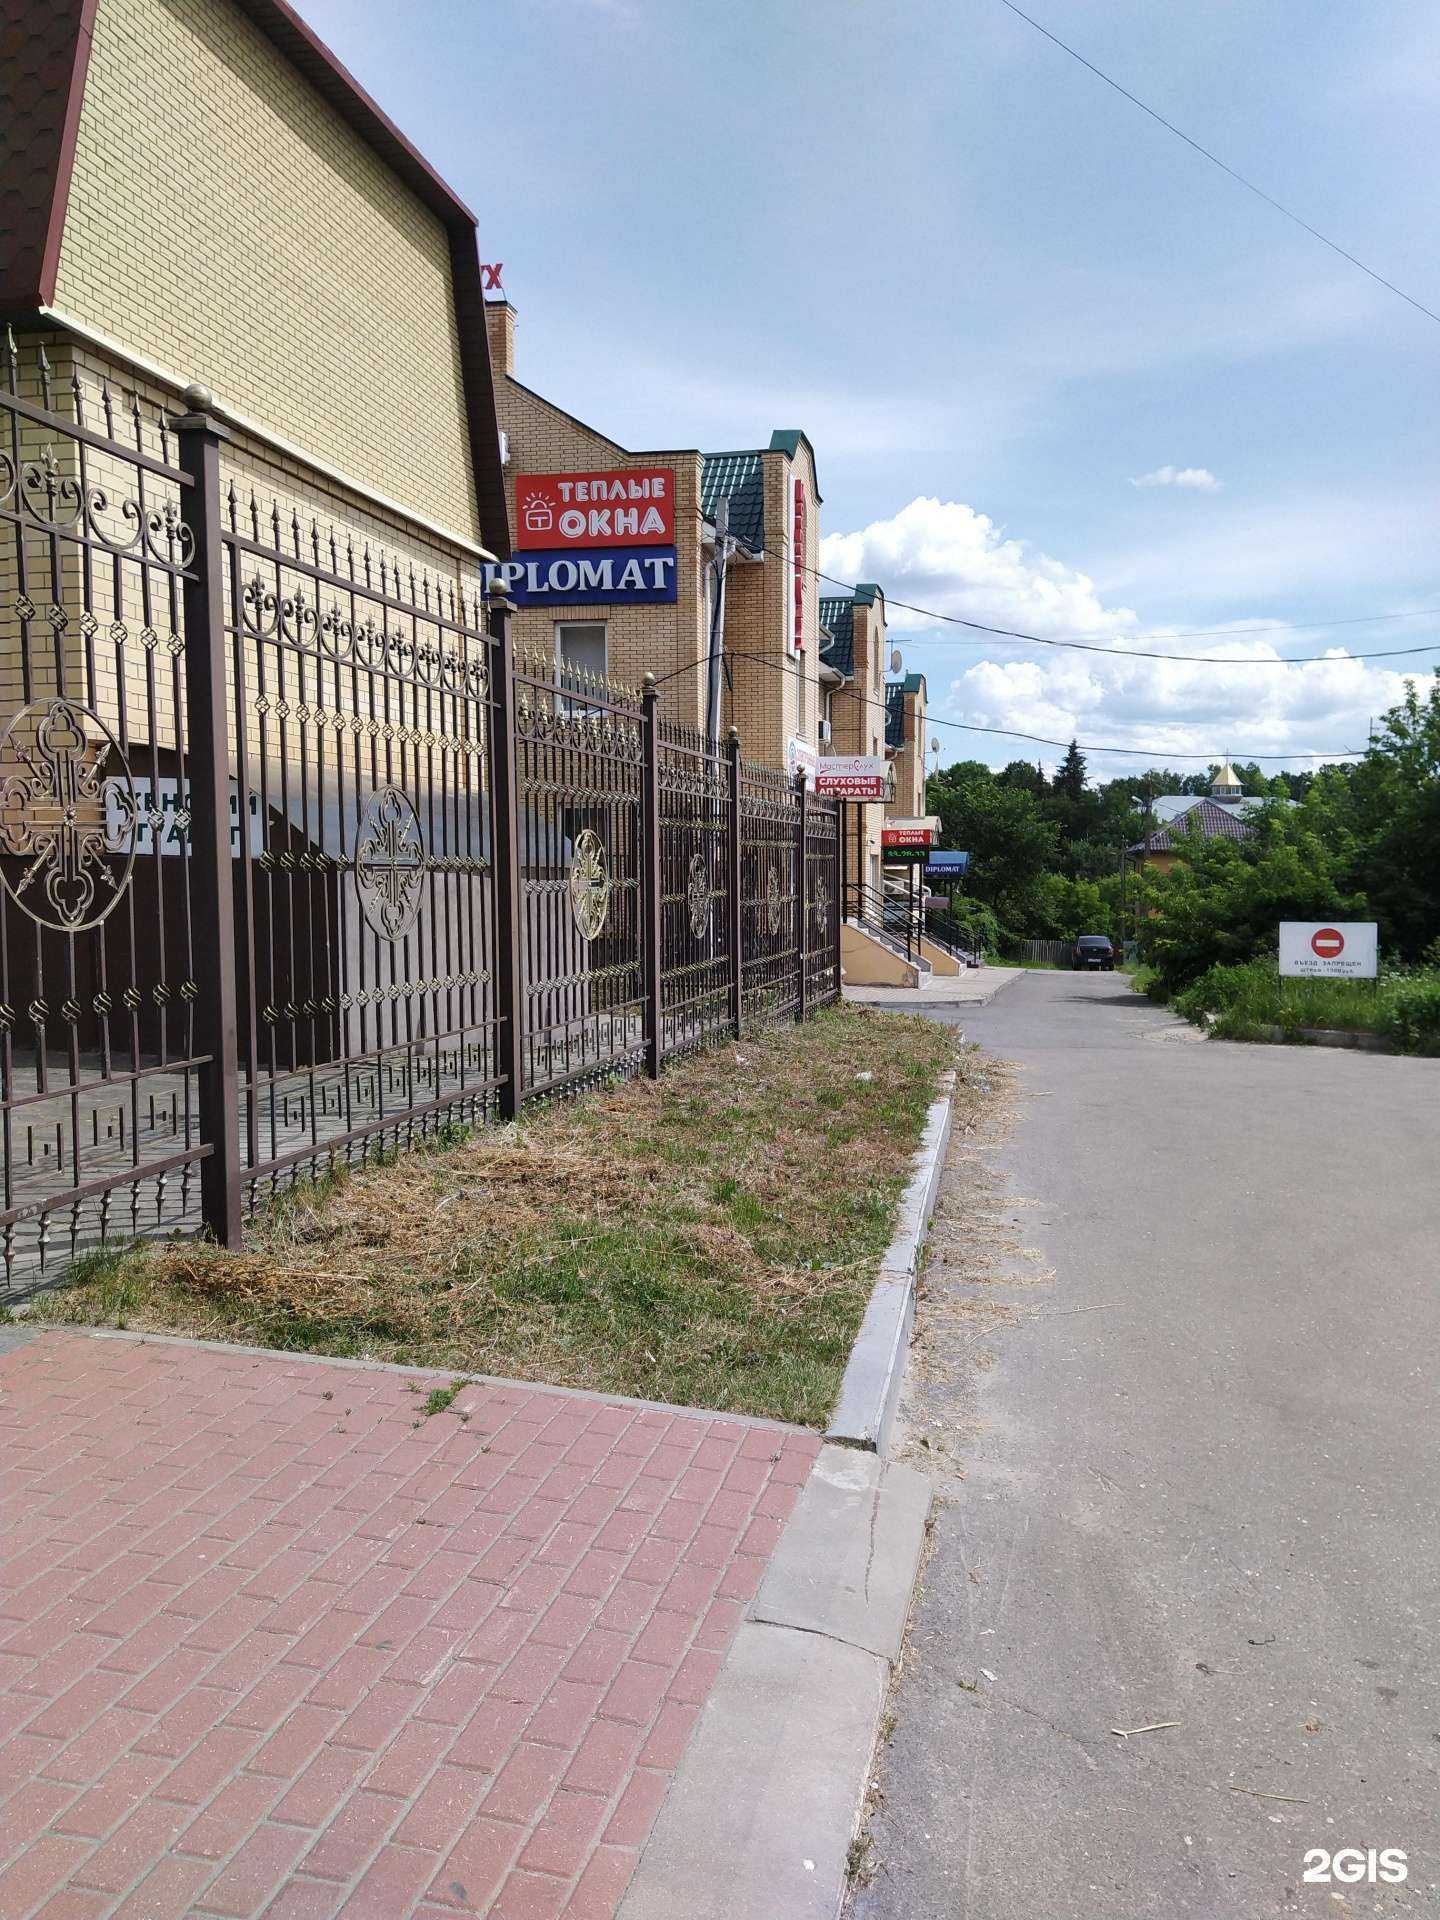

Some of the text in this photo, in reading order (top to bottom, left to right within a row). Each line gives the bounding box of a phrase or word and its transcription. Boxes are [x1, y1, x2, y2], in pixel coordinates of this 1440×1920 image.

[557, 477, 666, 503] ТЕПЛЫЕ
[558, 506, 667, 539] ОКНА
[480, 557, 674, 594] IPLOMAT
[819, 777, 877, 786] СЛУХОВЫЕ
